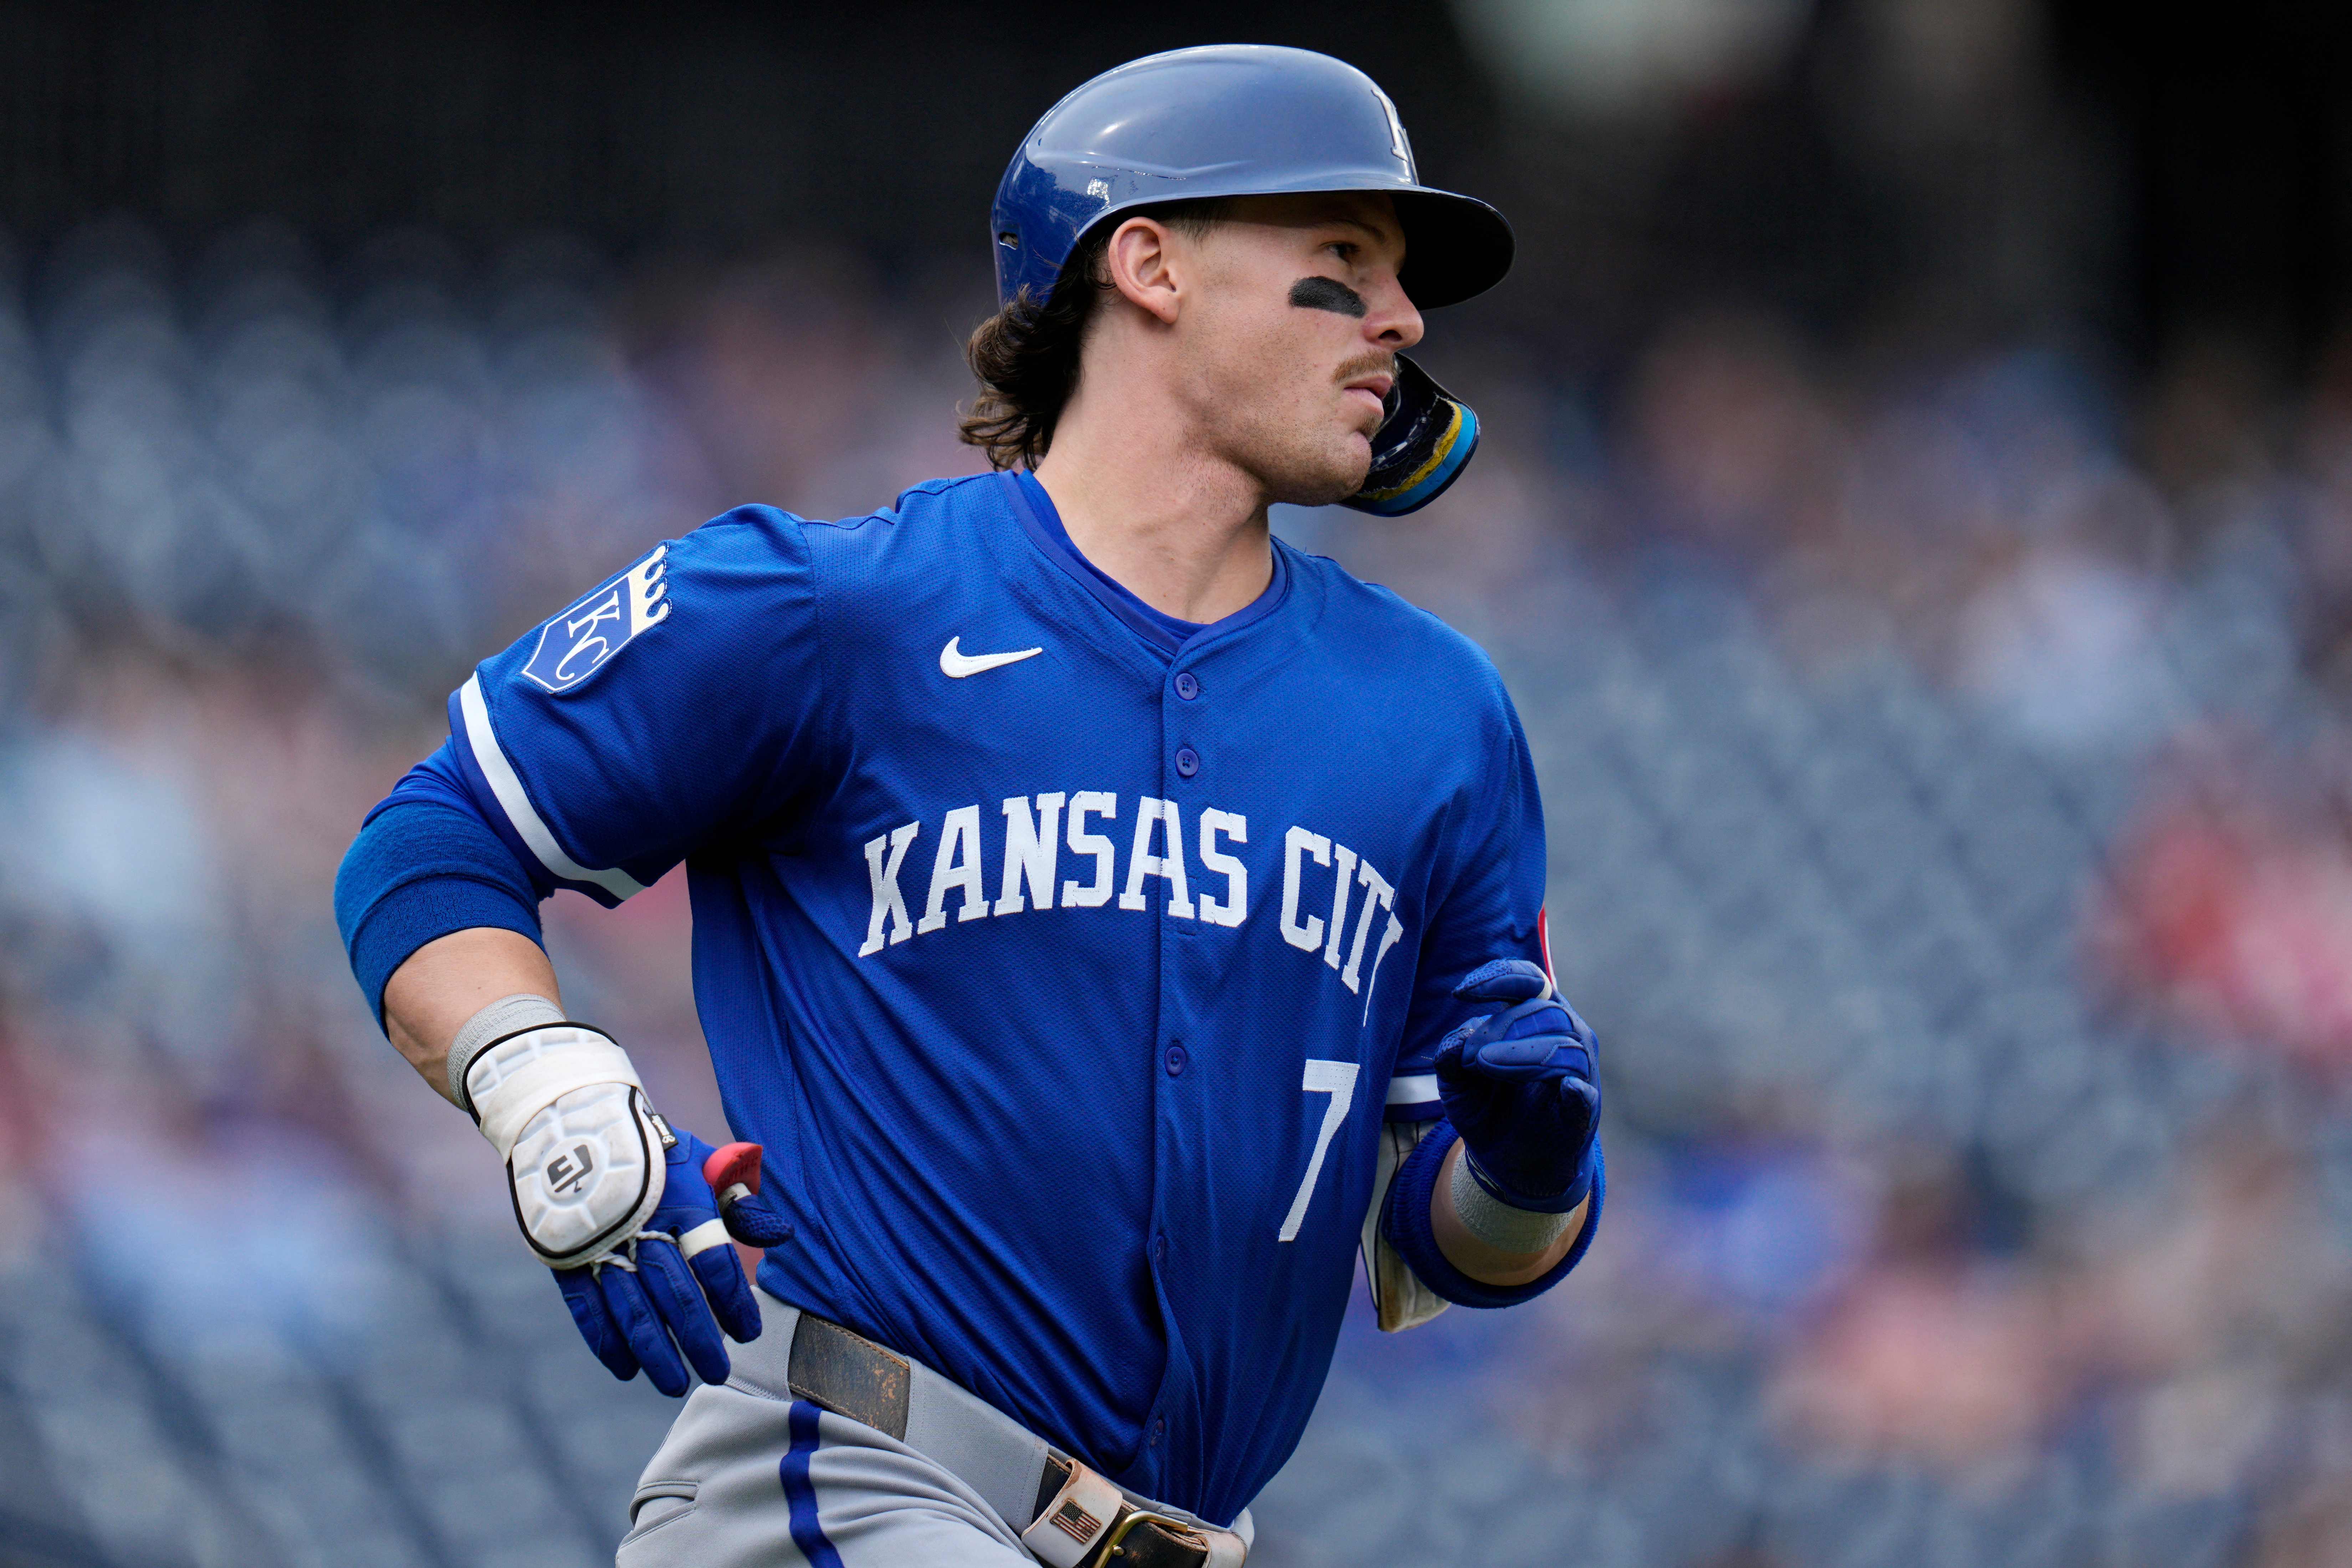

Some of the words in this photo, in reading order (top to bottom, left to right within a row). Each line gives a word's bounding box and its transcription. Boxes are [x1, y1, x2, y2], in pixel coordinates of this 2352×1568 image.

[556, 590, 620, 680] KC
[858, 790, 1248, 958] KANSAS
[1278, 1059, 1360, 1241] 7
